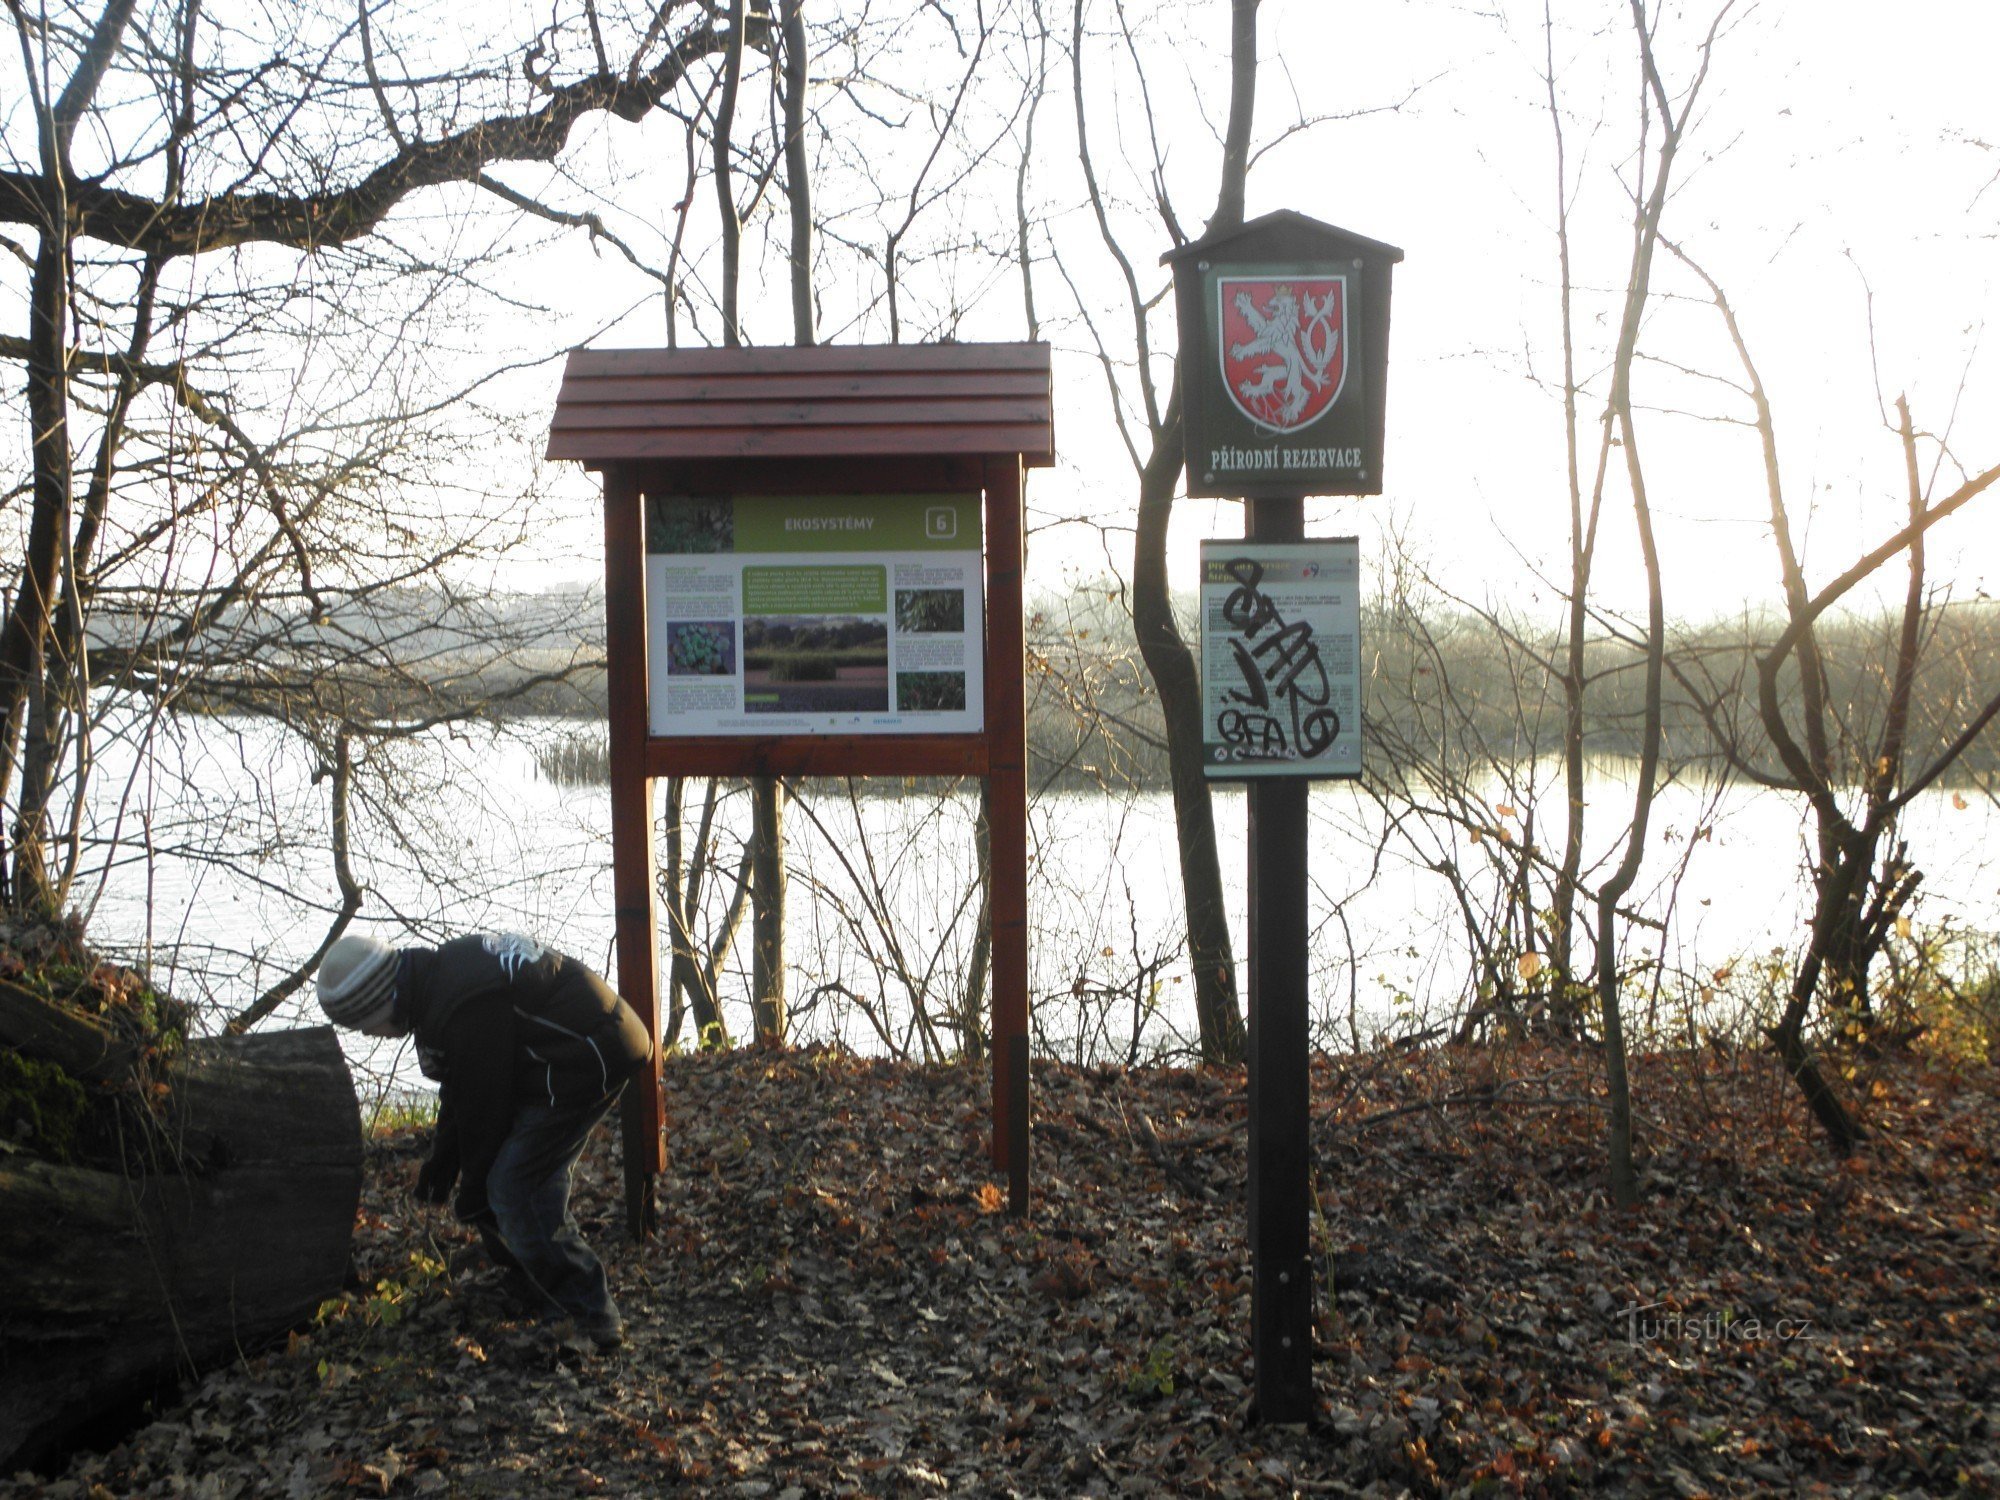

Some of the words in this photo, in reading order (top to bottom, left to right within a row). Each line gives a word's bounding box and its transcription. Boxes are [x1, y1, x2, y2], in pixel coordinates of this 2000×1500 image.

[1211, 445, 1278, 470] PŘÍRODNÍ
[1283, 447, 1362, 469] REZERVACE
[784, 514, 875, 531] EKOSYSTÉMY
[936, 514, 947, 531] 6
